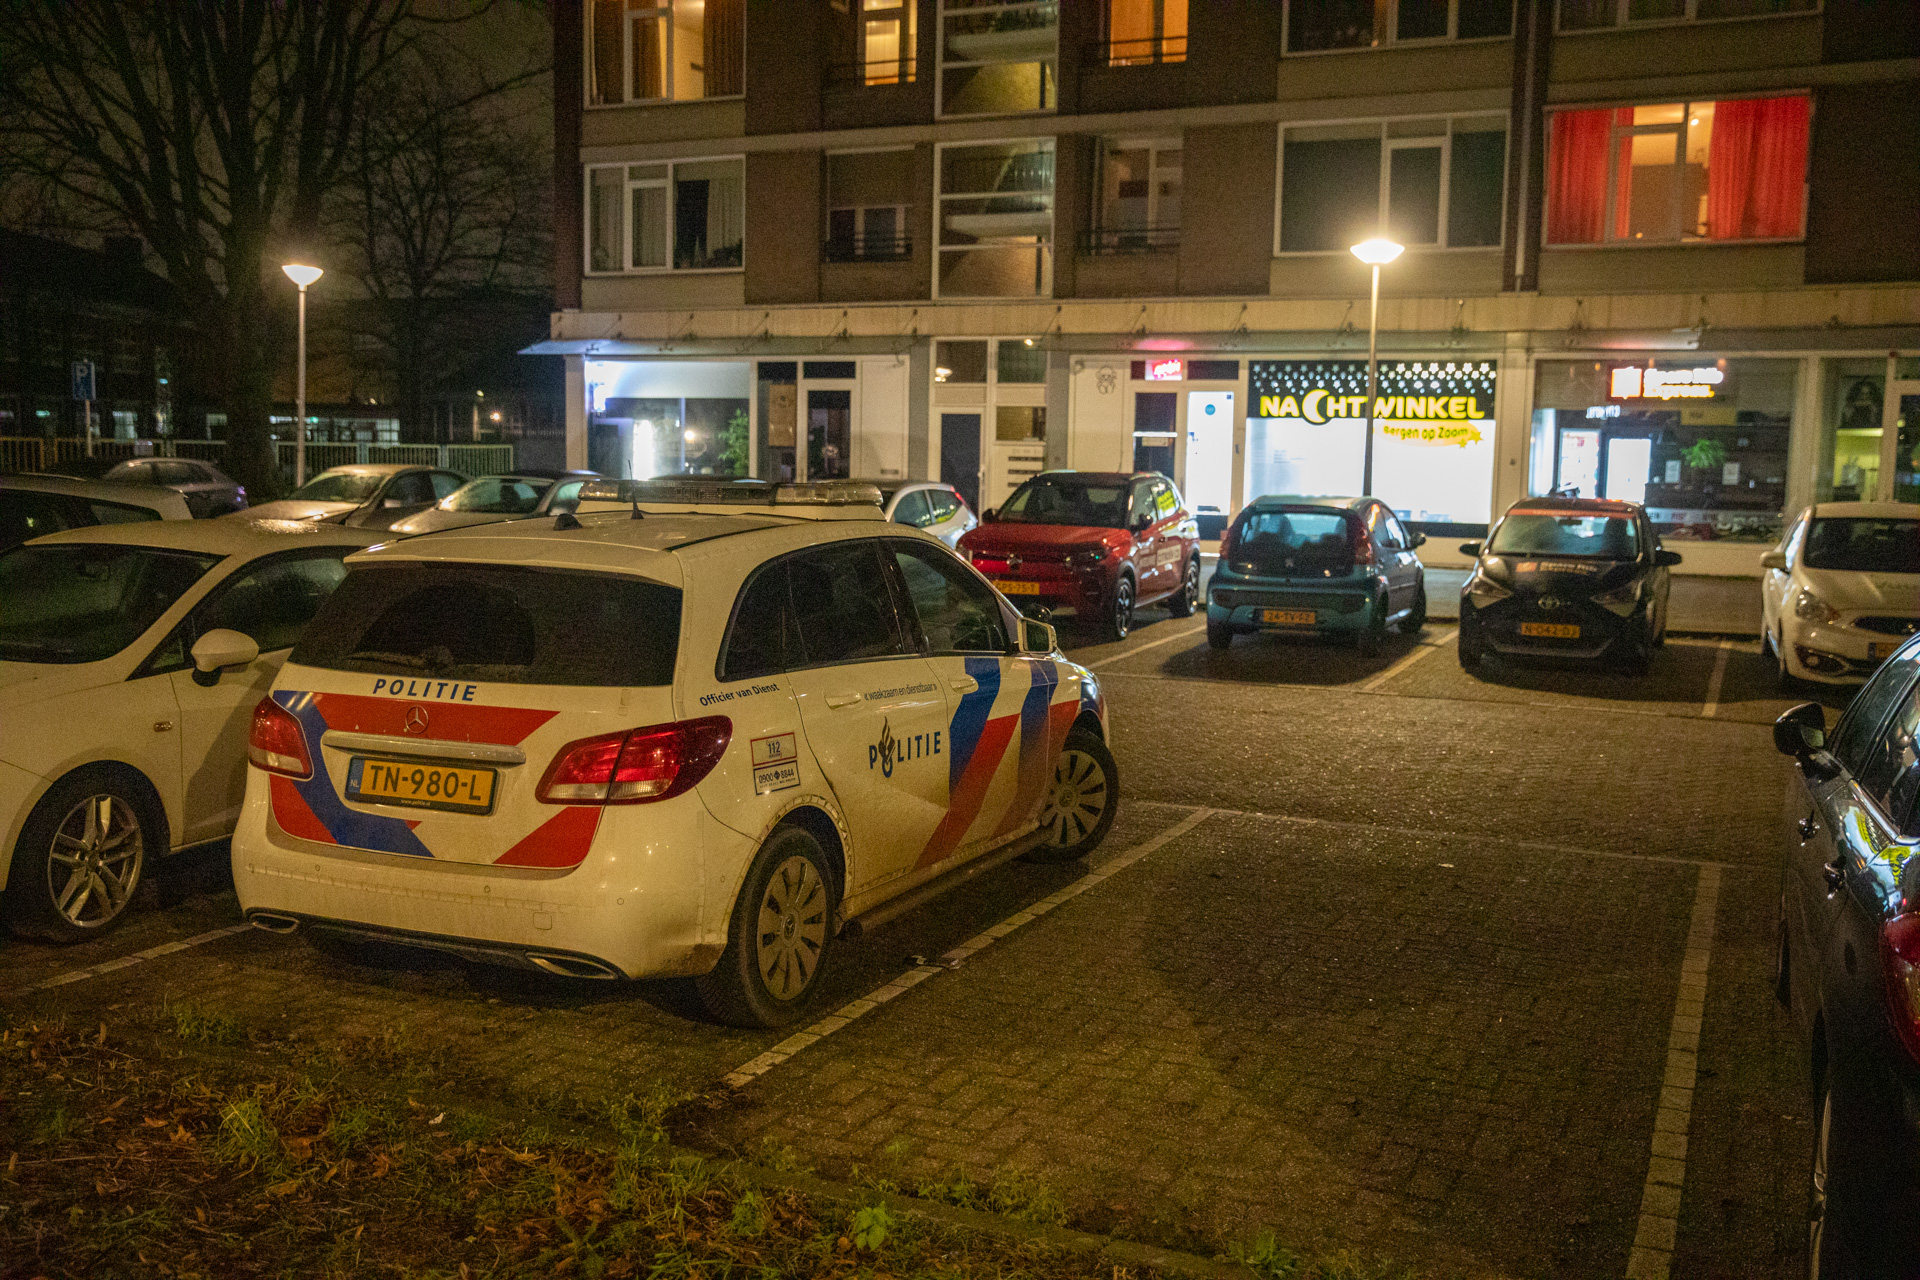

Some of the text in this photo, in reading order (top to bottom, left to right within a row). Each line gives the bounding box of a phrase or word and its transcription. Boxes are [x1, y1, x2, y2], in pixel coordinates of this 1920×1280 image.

[1383, 425, 1468, 441] Bergen op Zoom
[372, 678, 477, 702] POLITIE
[699, 682, 780, 707] Officier van Dienst
[768, 741, 781, 755] 112
[868, 731, 941, 778] POLITIE
[350, 779, 360, 788] NL
[370, 764, 482, 802] TN-980-L
[758, 772, 774, 784] 0900
[780, 768, 795, 779] 8844
